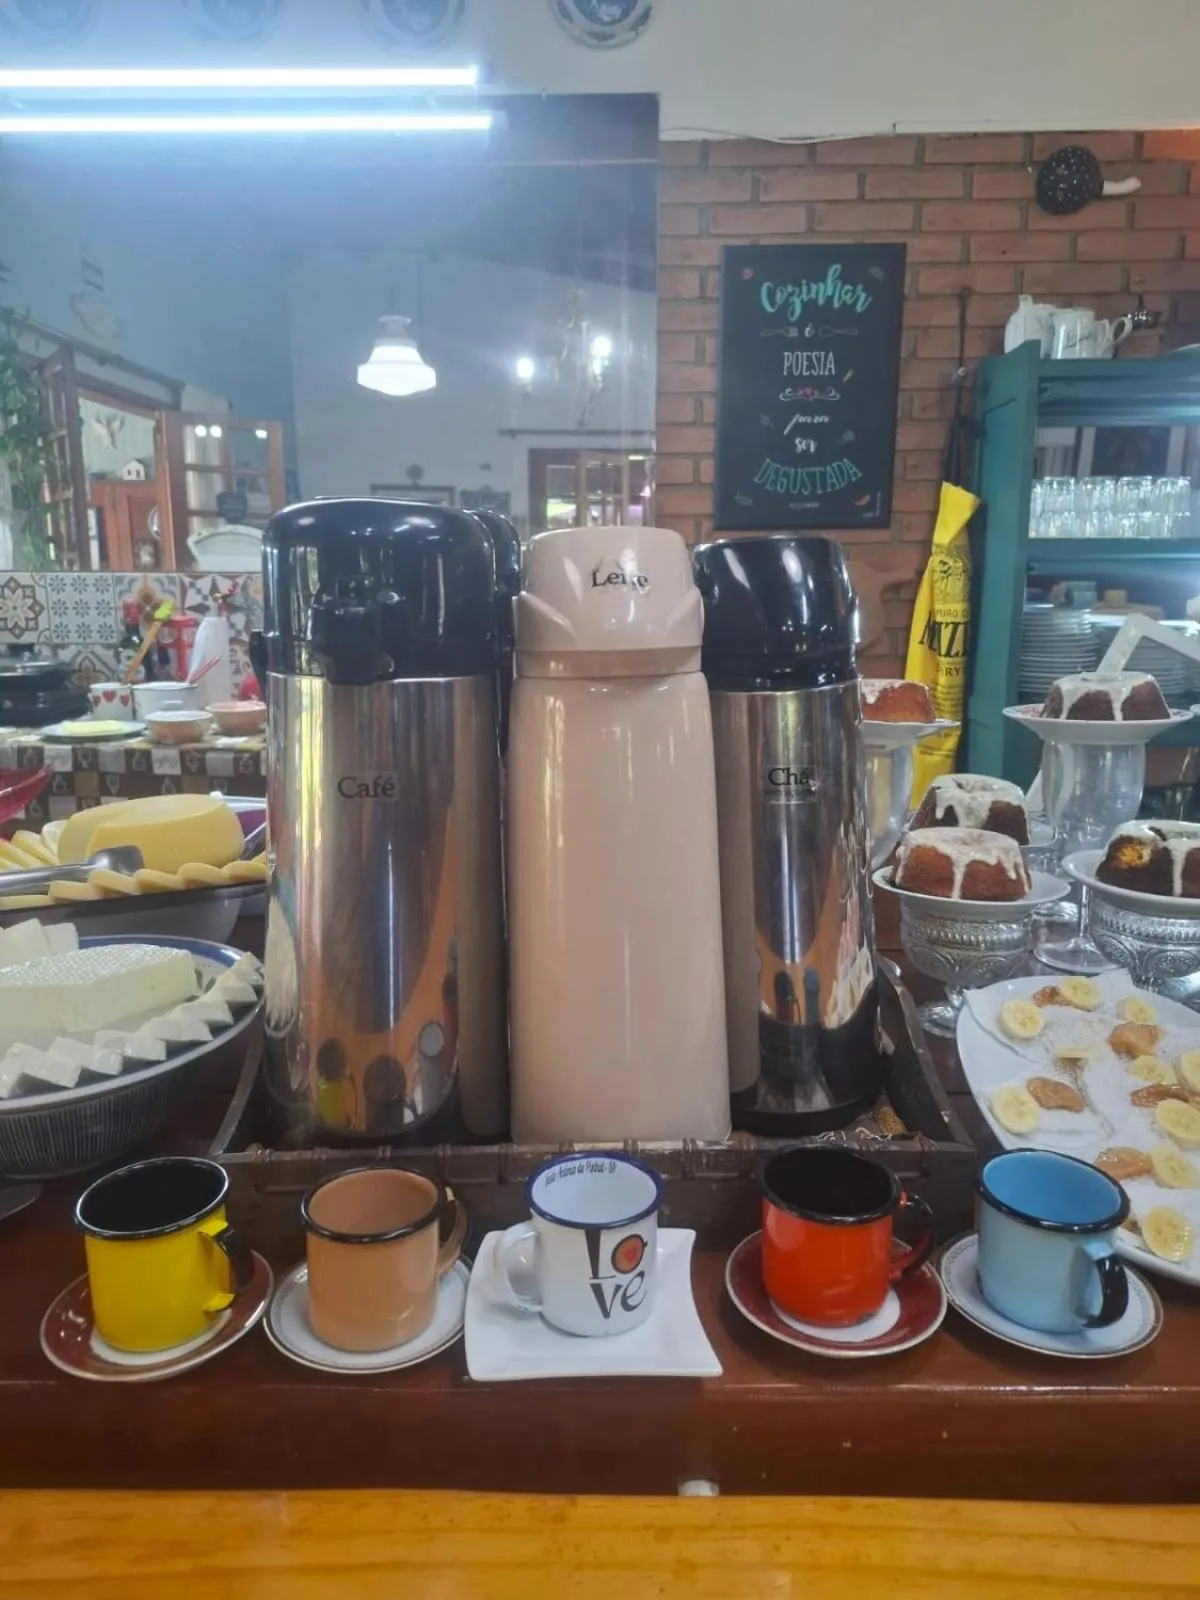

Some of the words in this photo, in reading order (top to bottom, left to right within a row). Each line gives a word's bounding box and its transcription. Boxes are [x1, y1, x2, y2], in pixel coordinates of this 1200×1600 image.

[760, 263, 872, 322] Cozinhar
[783, 351, 835, 376] POESIA
[753, 457, 863, 495] DEGUSTADA
[591, 568, 648, 588] Leie
[337, 775, 396, 799] Café
